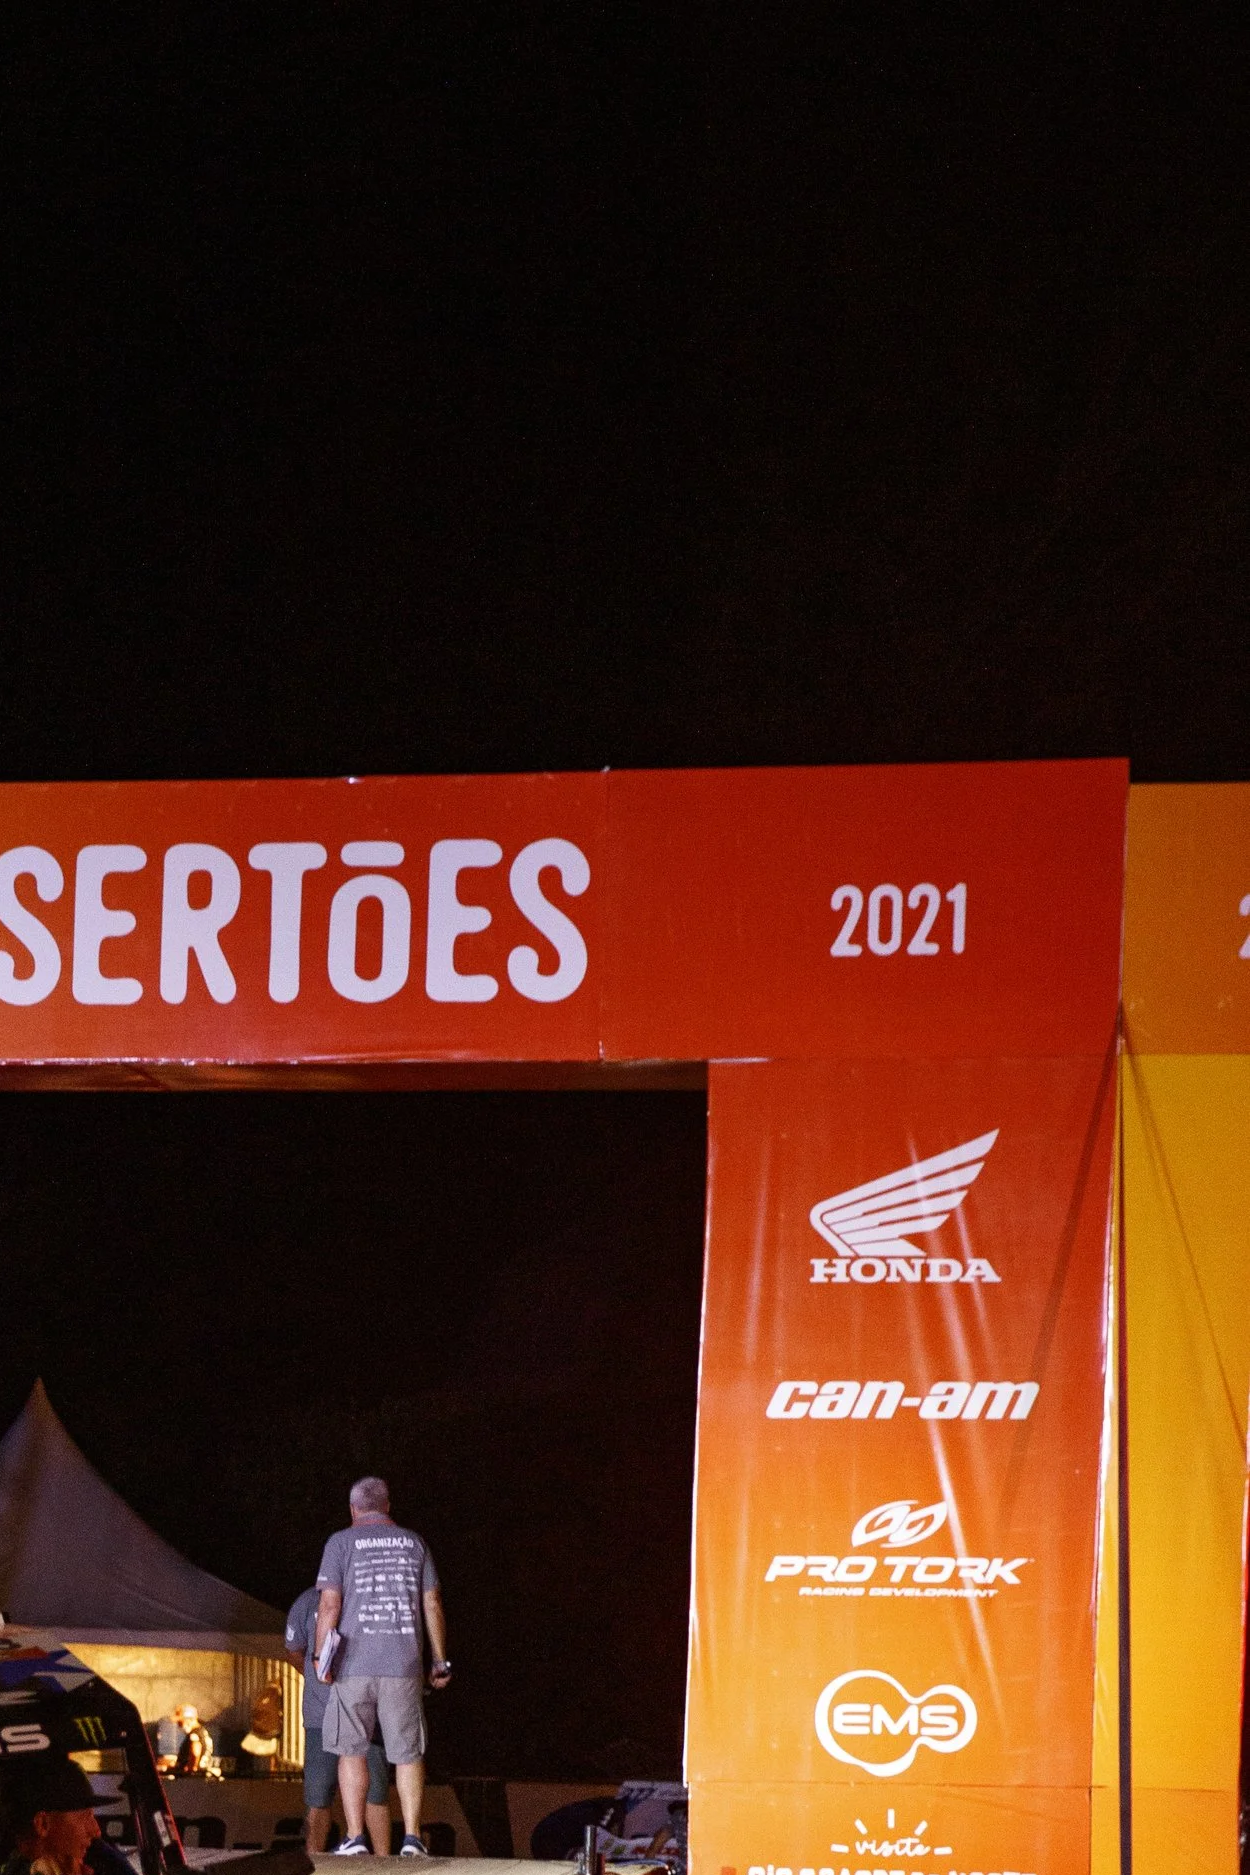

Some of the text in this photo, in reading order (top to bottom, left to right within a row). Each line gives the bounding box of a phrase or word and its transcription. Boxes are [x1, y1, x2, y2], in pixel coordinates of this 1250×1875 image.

[829, 882, 968, 958] 2021
[810, 1257, 1002, 1284] HONDA
[764, 1555, 1028, 1585] PRO TORK
[832, 1704, 959, 1737] EMS
